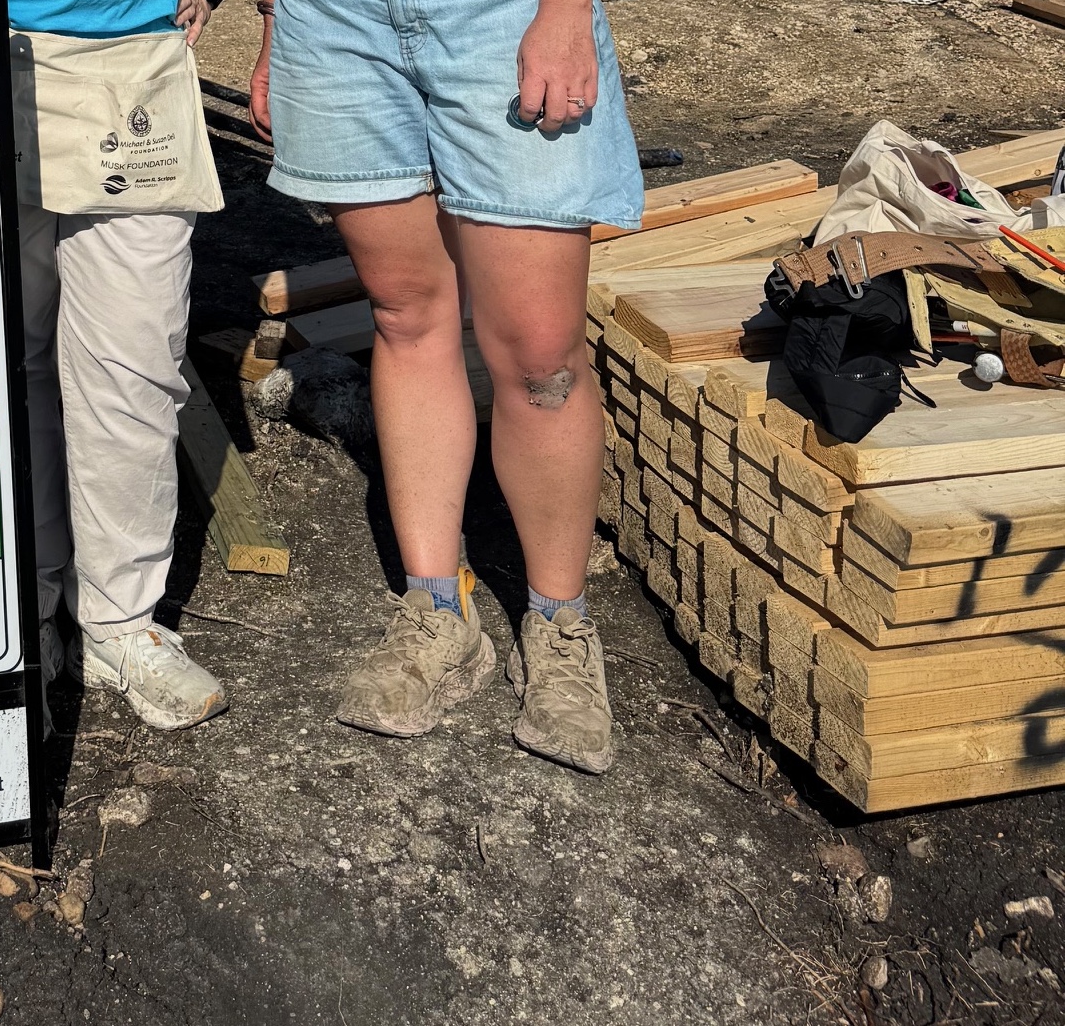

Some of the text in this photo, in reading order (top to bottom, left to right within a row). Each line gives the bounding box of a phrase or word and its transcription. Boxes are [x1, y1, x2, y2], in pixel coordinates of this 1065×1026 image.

[120, 140, 145, 148] Michael
[152, 136, 166, 145] Susan
[130, 145, 169, 155] FOUNDATION
[100, 157, 178, 170] MUSK FOUNDATION
